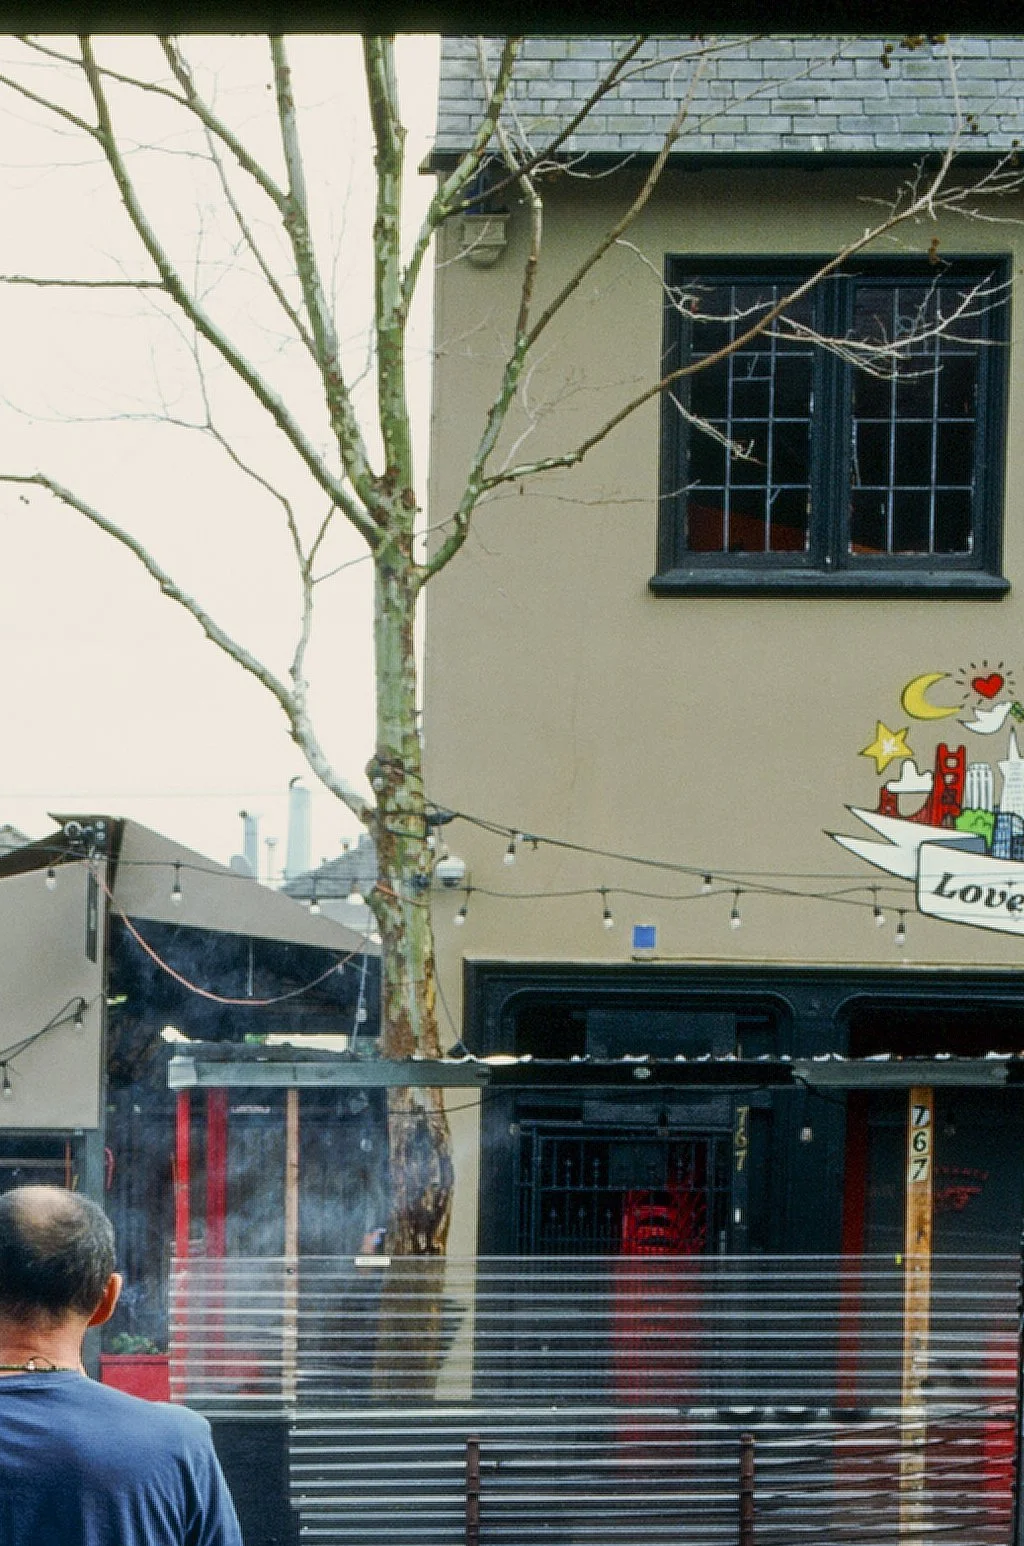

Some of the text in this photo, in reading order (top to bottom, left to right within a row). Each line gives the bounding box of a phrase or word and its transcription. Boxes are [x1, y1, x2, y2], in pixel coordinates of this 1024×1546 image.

[930, 870, 1024, 911] Love
[735, 1105, 749, 1173] 767
[912, 1105, 927, 1180] 767
